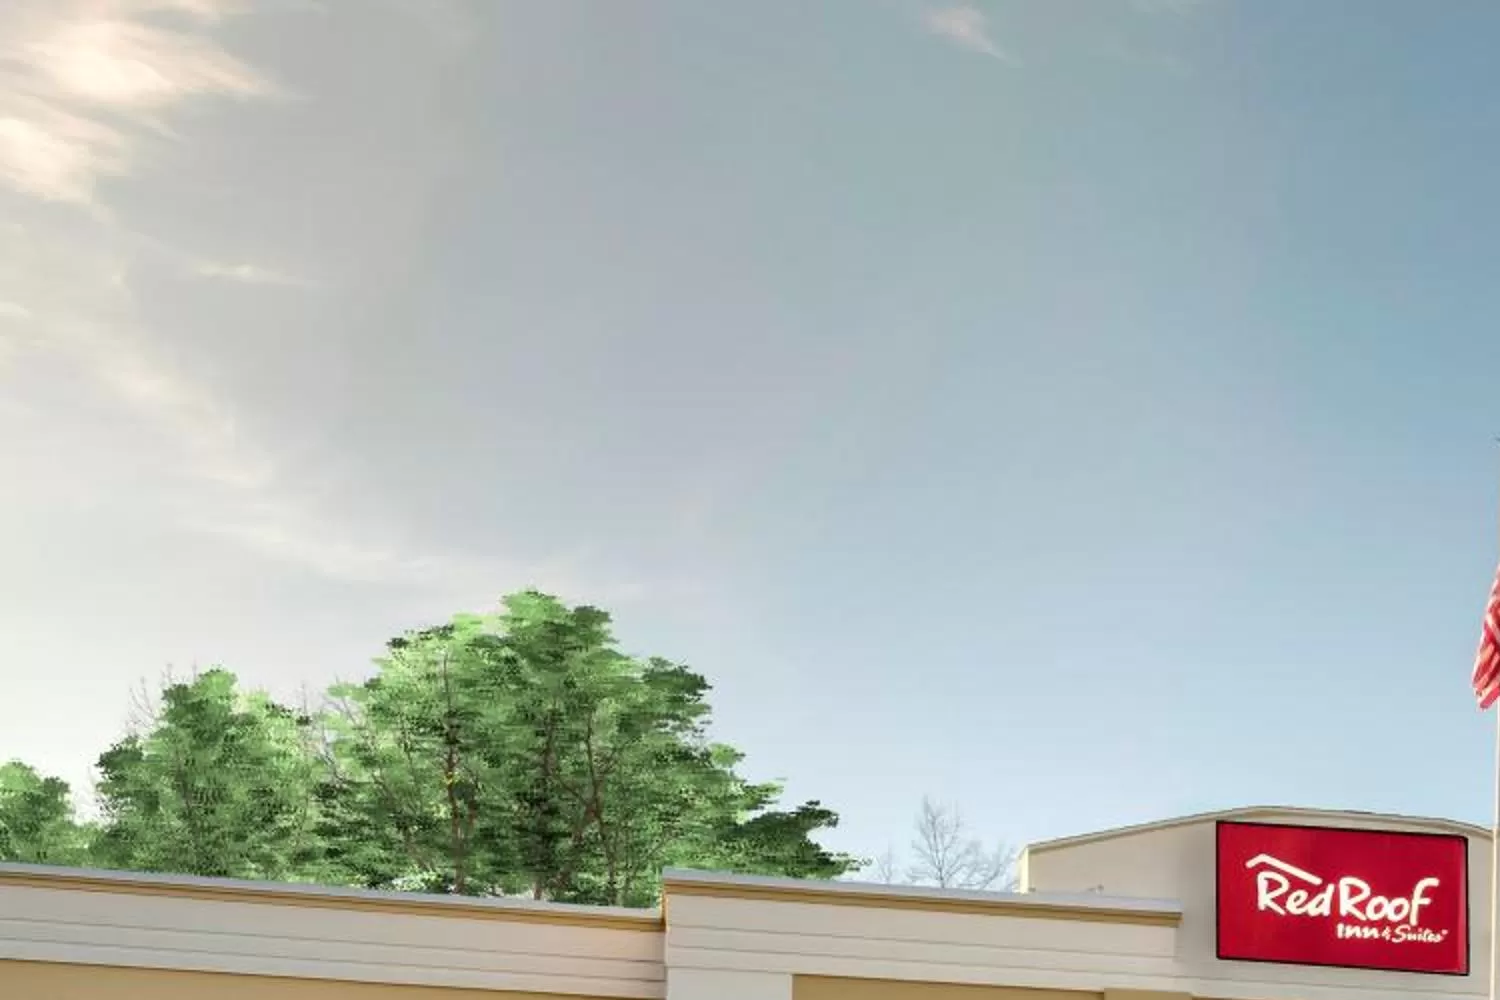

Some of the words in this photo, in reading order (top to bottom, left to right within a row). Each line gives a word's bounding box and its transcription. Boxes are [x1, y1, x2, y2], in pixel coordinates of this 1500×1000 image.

[1256, 870, 1335, 917] Red
[1338, 876, 1440, 926] Roof
[1337, 923, 1379, 939] Inn
[1381, 926, 1391, 941] &
